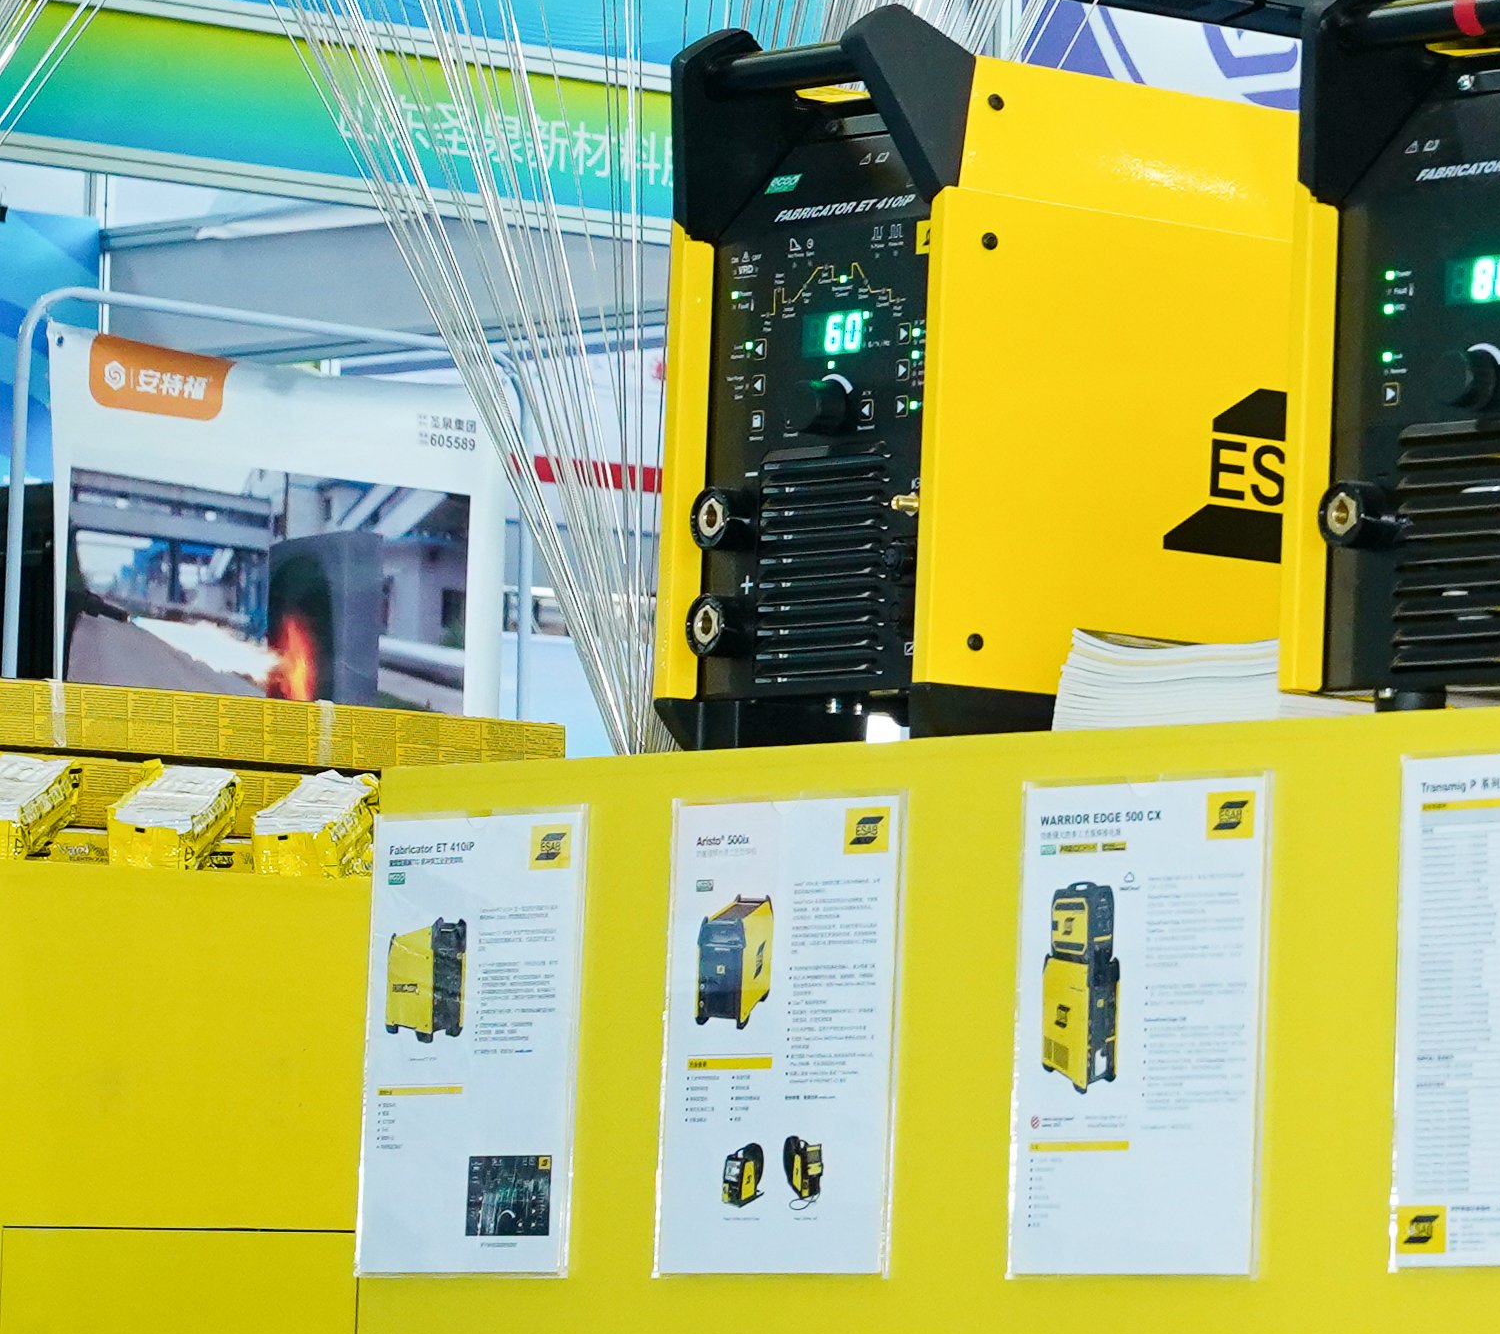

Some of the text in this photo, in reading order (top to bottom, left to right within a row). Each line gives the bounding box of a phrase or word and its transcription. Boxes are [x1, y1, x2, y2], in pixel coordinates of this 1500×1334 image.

[774, 200, 854, 223] FABRICATOR
[856, 198, 878, 213] ET
[824, 312, 863, 355] 60
[137, 368, 209, 402] 安特福
[429, 433, 477, 453] 605589
[1420, 779, 1467, 794] Transmig
[1040, 810, 1162, 827] WARRIOR EDGE 500 CX
[389, 844, 435, 856] Fabricator
[436, 843, 448, 853] ET
[539, 840, 562, 852] ESAB
